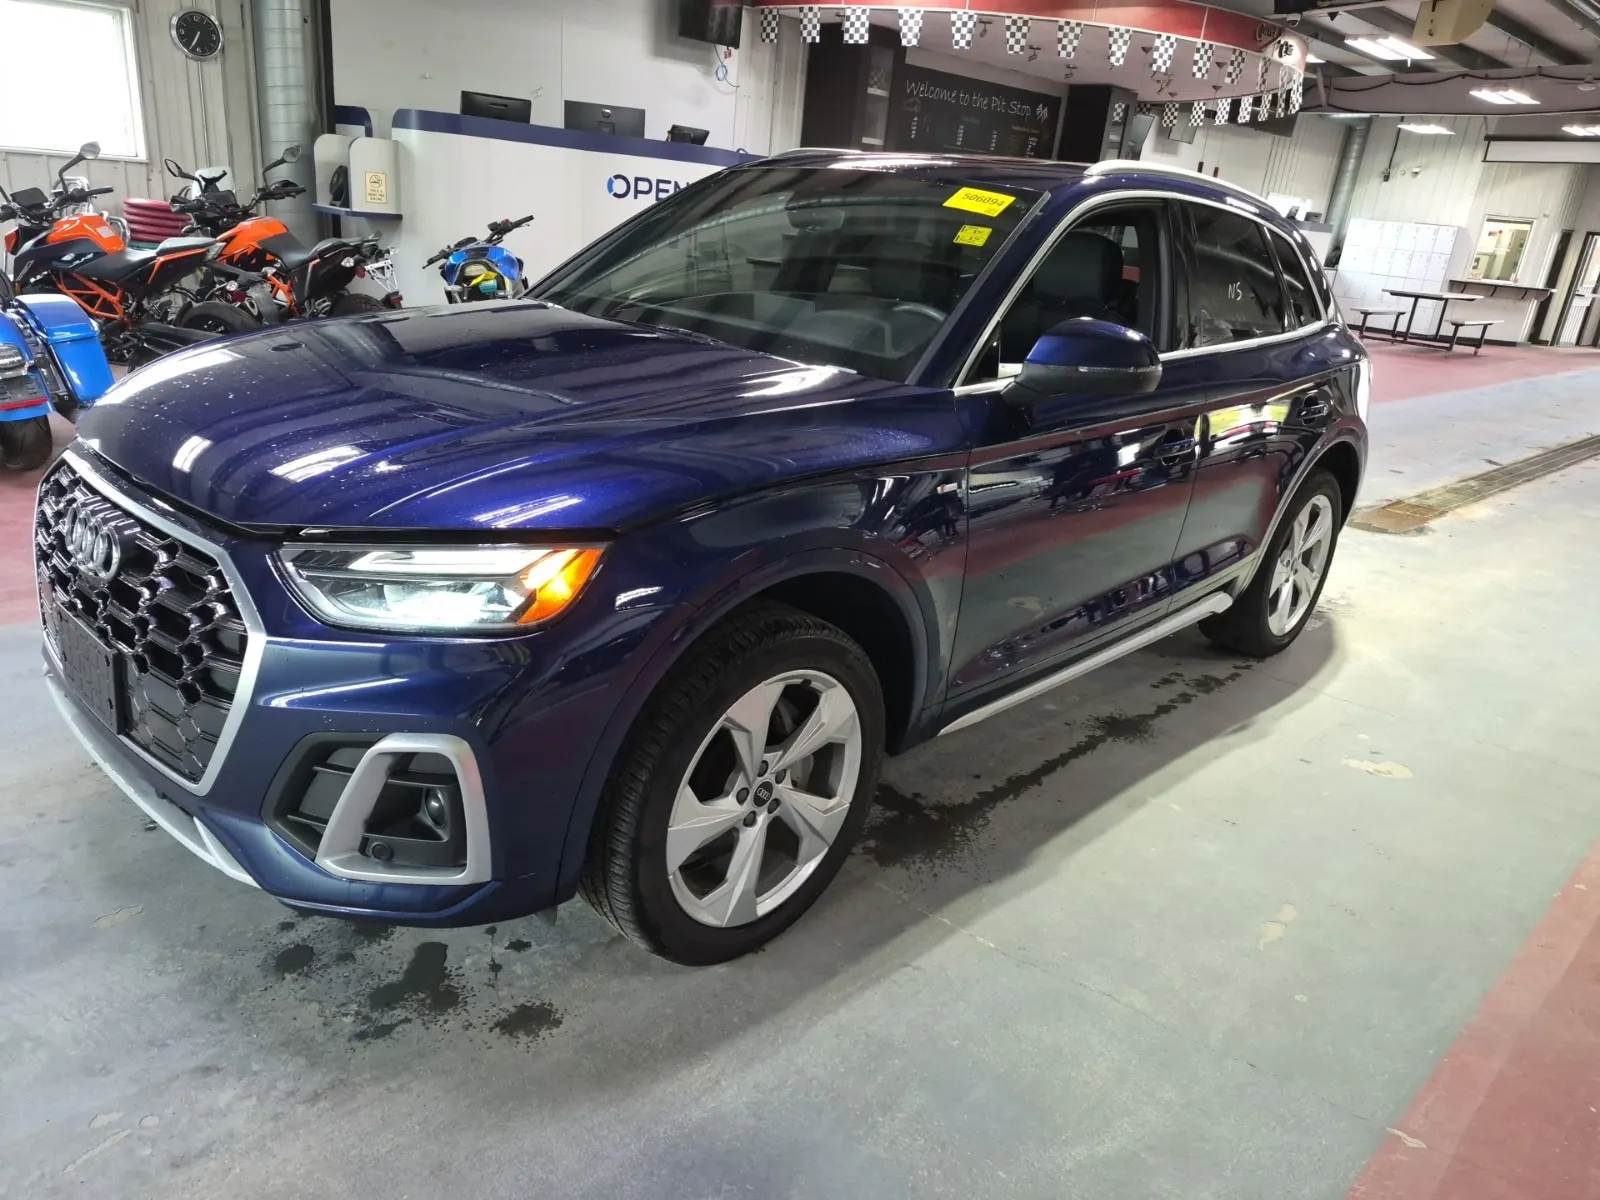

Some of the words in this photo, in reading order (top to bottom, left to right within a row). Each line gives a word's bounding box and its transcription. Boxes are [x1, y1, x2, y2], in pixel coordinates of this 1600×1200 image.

[906, 80, 957, 103] Welcome
[959, 90, 970, 106] to
[972, 92, 988, 110] the
[991, 96, 1006, 113] Pit
[1008, 101, 1031, 122] Stop
[962, 193, 1005, 206] 506094
[1228, 281, 1242, 301] NS
